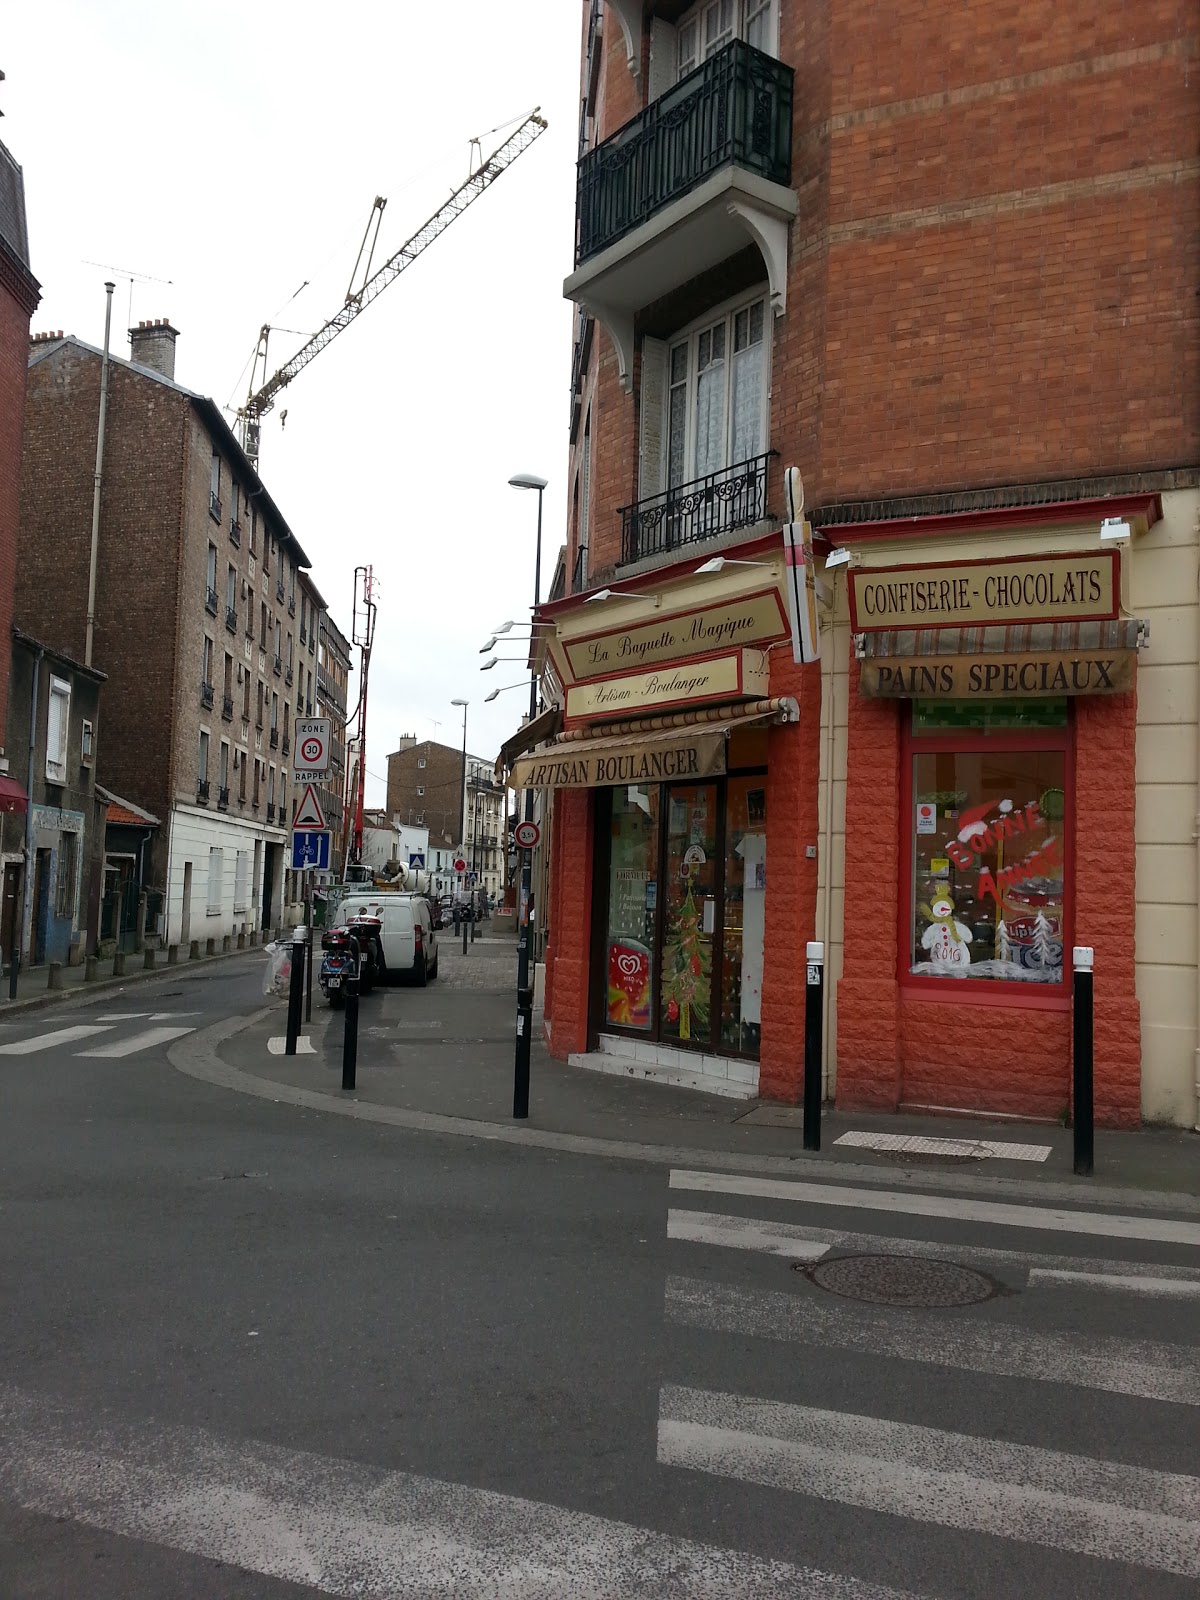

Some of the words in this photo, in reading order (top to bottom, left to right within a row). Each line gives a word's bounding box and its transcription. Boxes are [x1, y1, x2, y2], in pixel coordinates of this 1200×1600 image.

[864, 578, 971, 615] CONFISERIE
[984, 569, 1101, 608] CHOCOLATS
[588, 643, 610, 665] La
[616, 631, 676, 660] Baguette
[682, 614, 755, 644] Magique
[587, 685, 632, 706] Artisan
[641, 672, 709, 696] Boulanger
[876, 664, 954, 694] PAINS
[968, 659, 1116, 693] SPECIAUX
[301, 725, 325, 733] ZONE
[306, 745, 318, 755] 30
[523, 759, 590, 786] ARTISAN
[596, 748, 699, 781] BOULANGER
[295, 771, 330, 782] RAPPEL
[945, 801, 1041, 870] BONNE
[1009, 924, 1041, 938] Lipt
[933, 943, 961, 962] 2016
